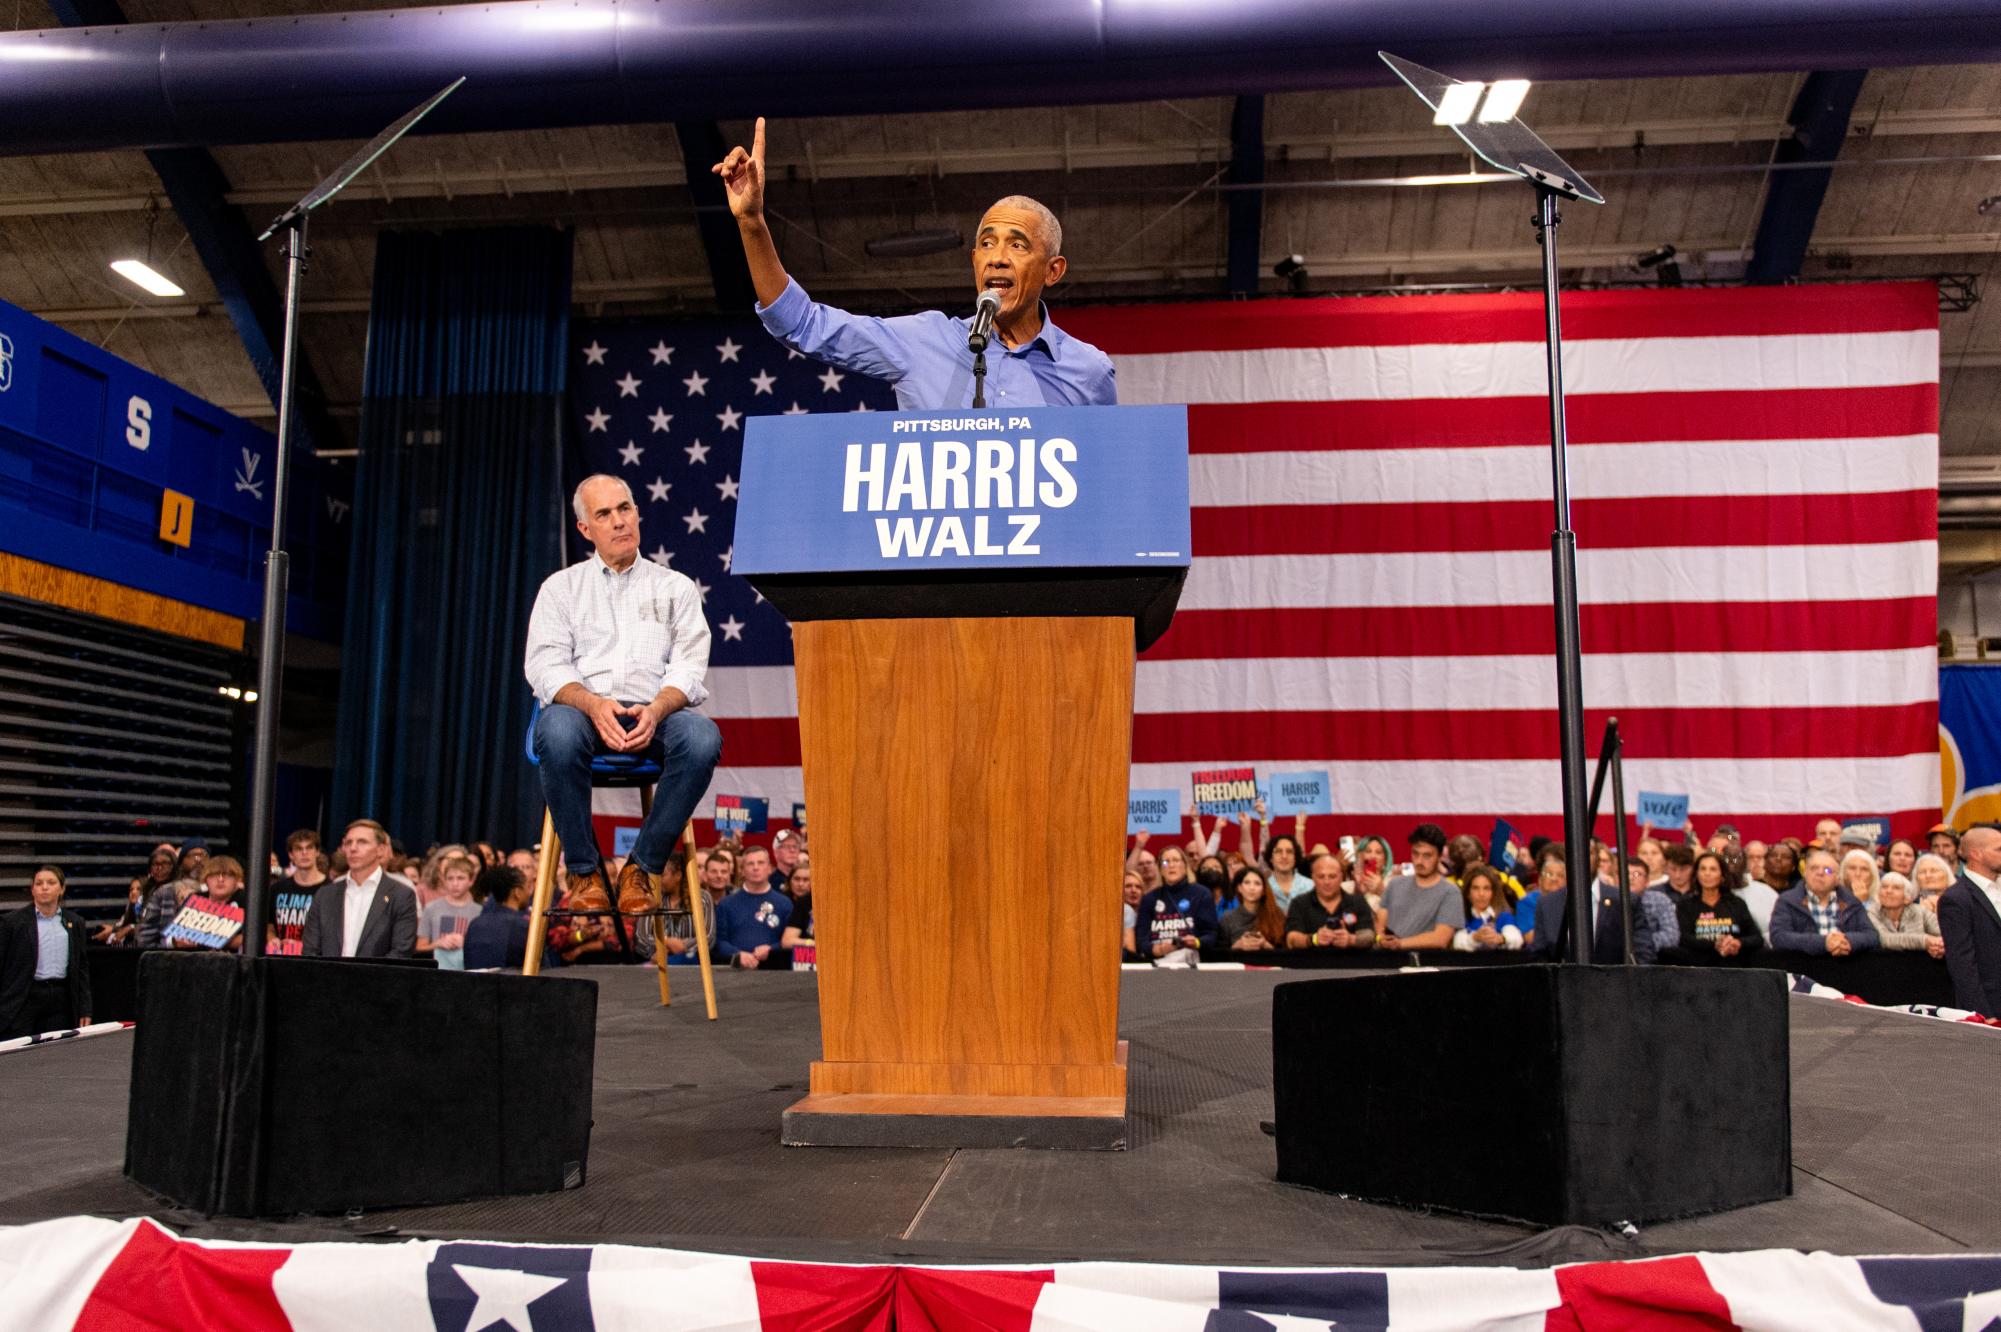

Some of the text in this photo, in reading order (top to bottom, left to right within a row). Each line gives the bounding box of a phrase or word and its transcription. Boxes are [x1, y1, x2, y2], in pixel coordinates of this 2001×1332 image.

[126, 395, 152, 451] S
[892, 417, 1031, 433] PITTSBURGH, PA
[842, 437, 1078, 513] HARRIS
[171, 502, 182, 535] J
[875, 514, 1041, 558] WALZ
[1194, 779, 1256, 803] FREEDOM
[1281, 781, 1320, 797] HARRIS
[1128, 799, 1168, 815] HARRIS
[1288, 796, 1315, 805] WALZ
[1644, 799, 1683, 817] vote
[1133, 814, 1162, 824] WALZ
[276, 892, 313, 912] CLIMA
[173, 906, 242, 938] FREEDOM
